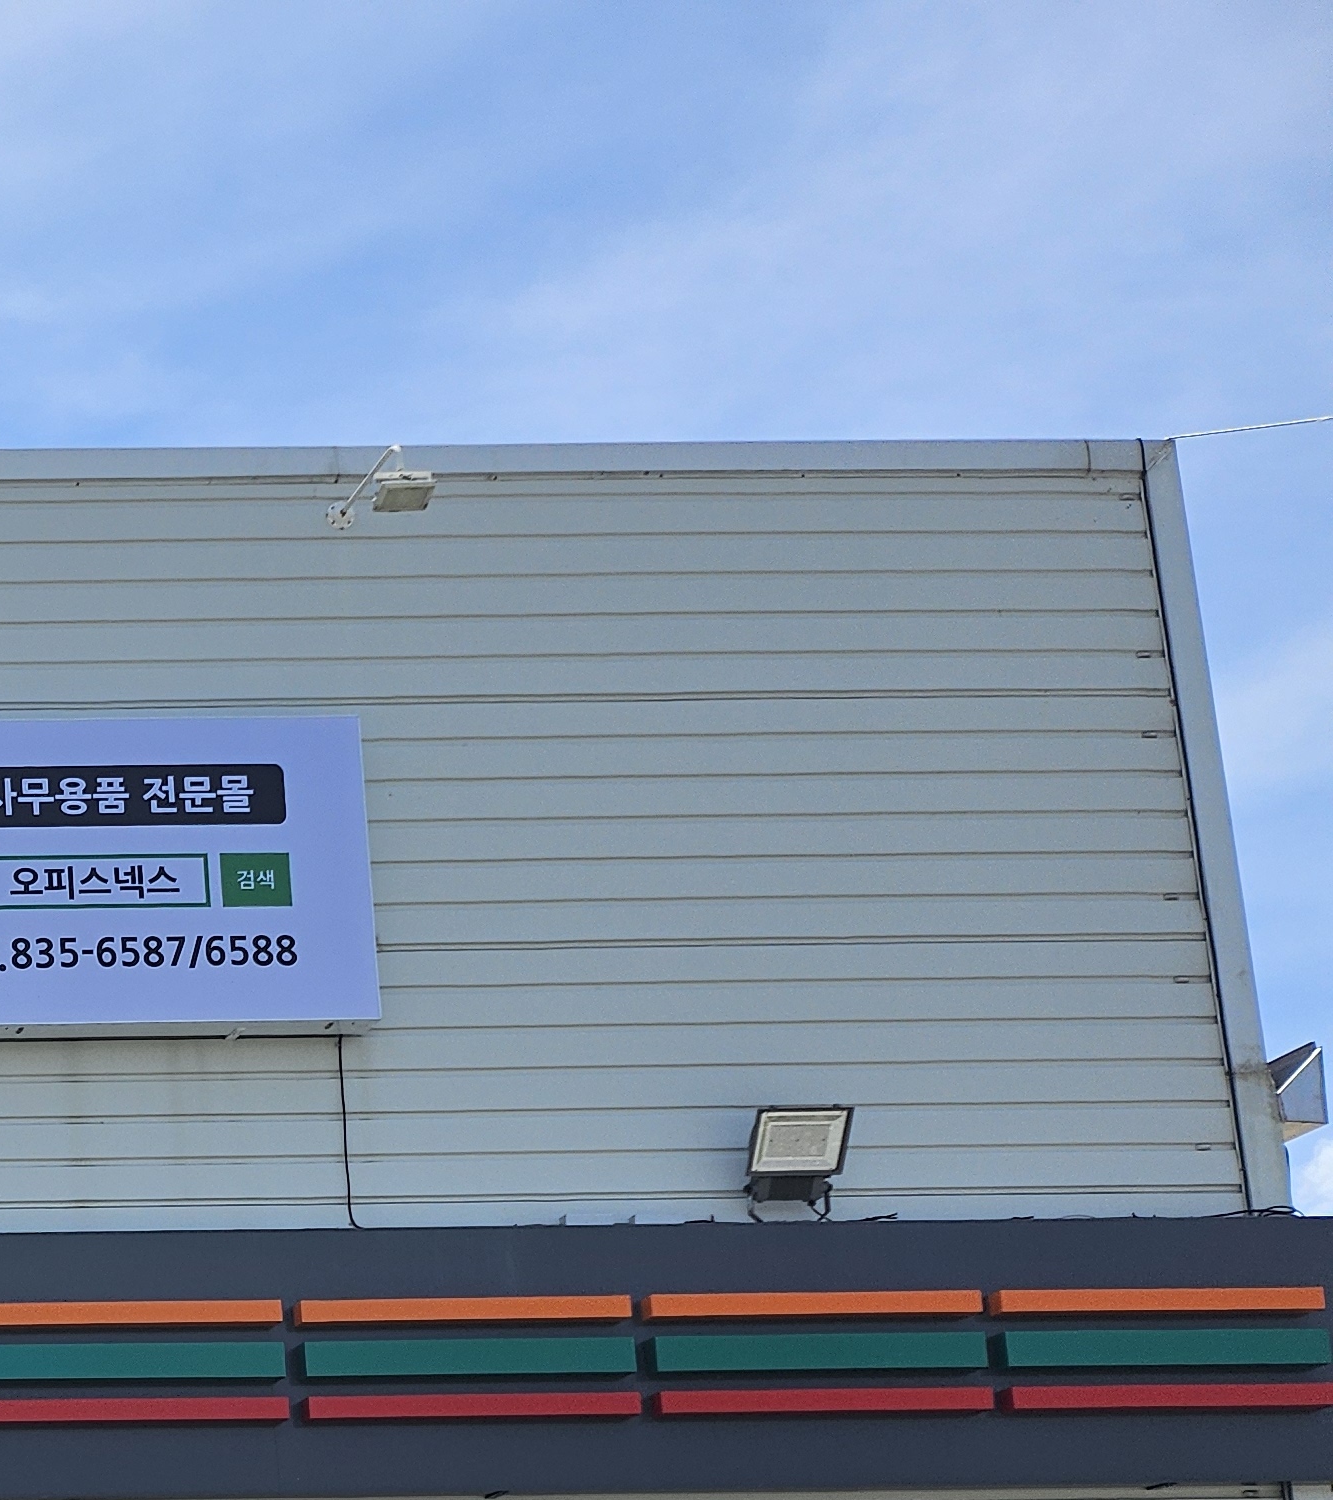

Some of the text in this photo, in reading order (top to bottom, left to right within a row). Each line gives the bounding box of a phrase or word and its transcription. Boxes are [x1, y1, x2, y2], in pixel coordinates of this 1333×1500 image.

[142, 773, 255, 814] 전문몰
[10, 865, 181, 900] 오피스넥스
[236, 868, 276, 890] 검색
